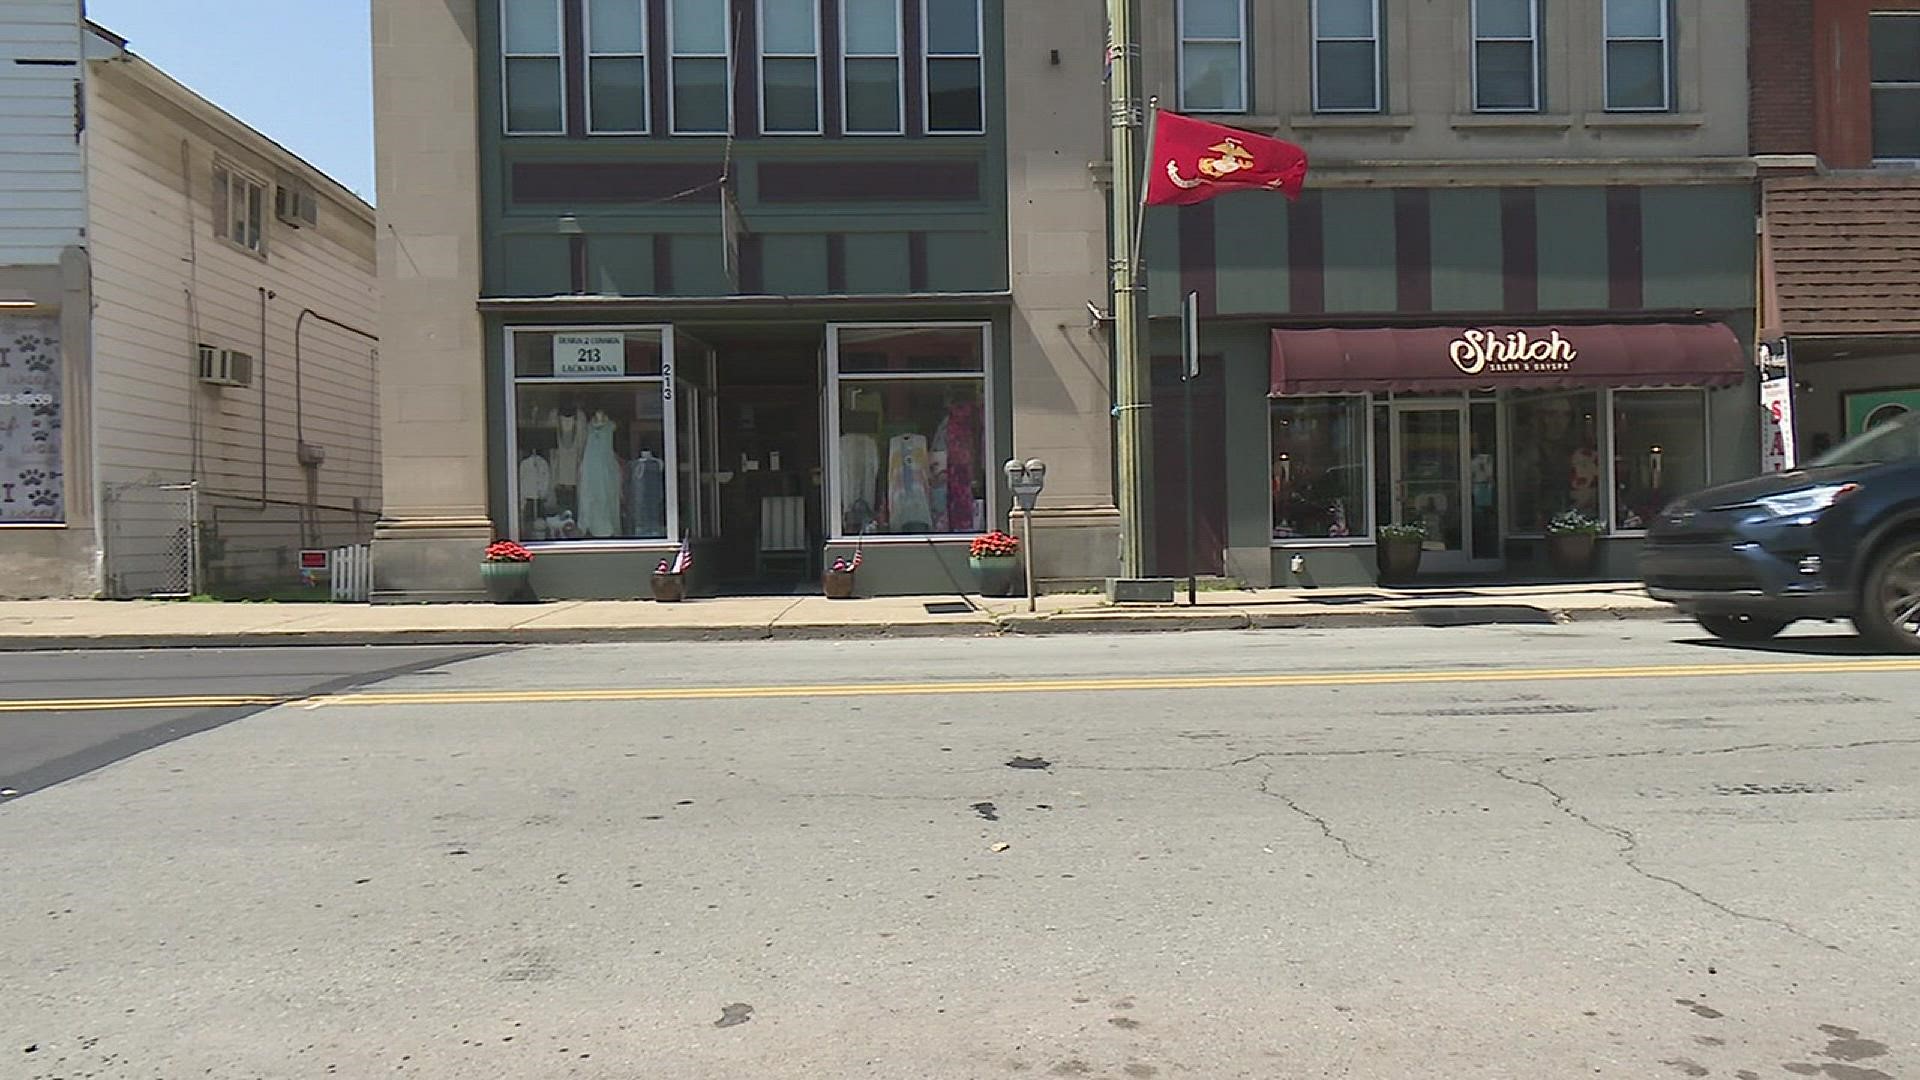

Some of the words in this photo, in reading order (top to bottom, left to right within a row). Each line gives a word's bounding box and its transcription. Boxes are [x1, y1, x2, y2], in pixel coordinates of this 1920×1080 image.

[577, 348, 601, 362] 213
[1448, 328, 1577, 375] Shiloh
[1489, 363, 1520, 371] SALON
[663, 364, 672, 400] 213
